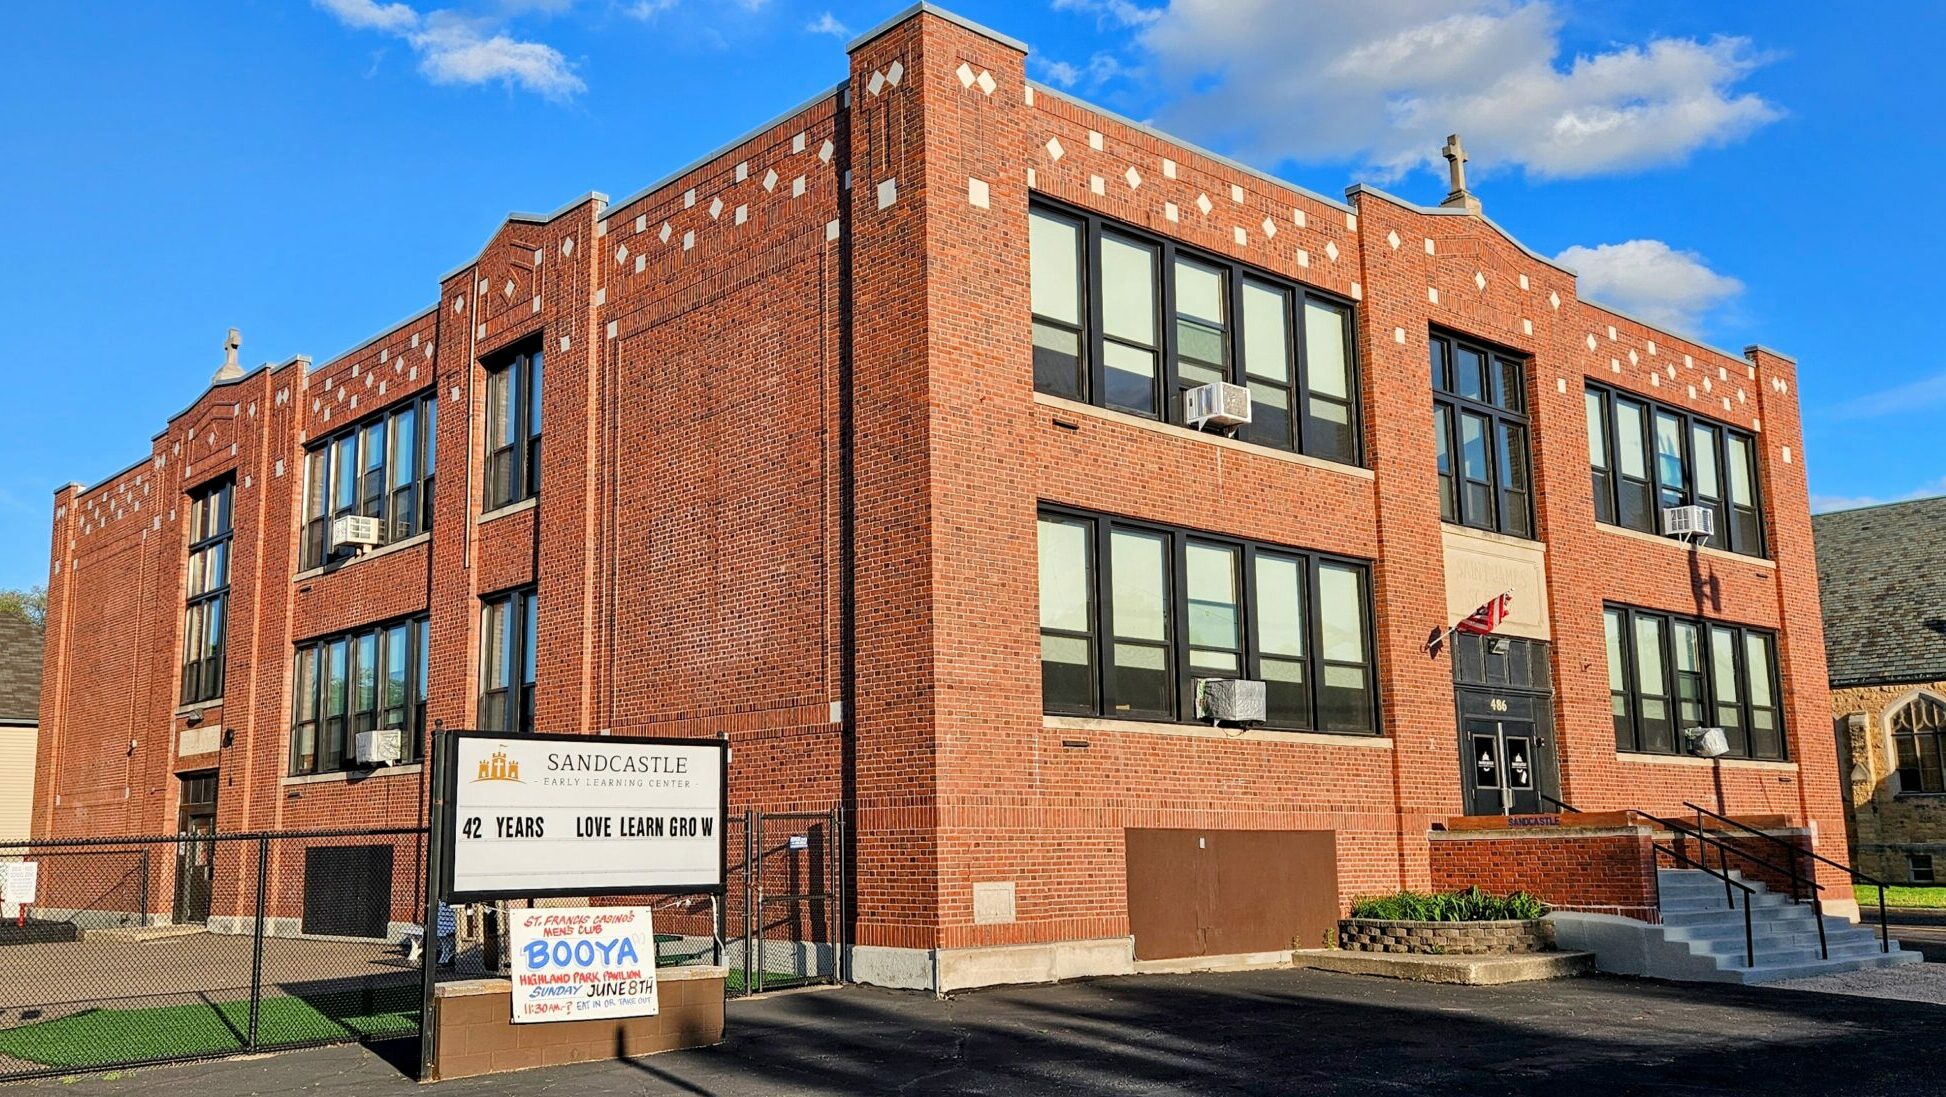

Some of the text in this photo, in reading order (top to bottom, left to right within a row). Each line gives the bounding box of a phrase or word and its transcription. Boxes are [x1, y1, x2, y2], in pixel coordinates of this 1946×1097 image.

[1490, 698, 1507, 712] 486
[547, 753, 688, 773] SANDCASTLE
[544, 777, 691, 788] EARLY LEARNING CENTER
[462, 817, 482, 838] 42
[496, 816, 544, 838] YEARS
[576, 816, 611, 838] LOVE
[620, 816, 664, 837] LEARN
[1508, 817, 1560, 827] SANDCASTLE
[523, 915, 542, 928] ST.
[543, 914, 591, 927] FRANCIS
[578, 924, 603, 935] CLUB
[523, 937, 639, 969] BOOYA
[519, 969, 642, 986] HIGHLAND PARK PAVILION
[528, 979, 654, 998] SUNDAY JUNE 8TH
[576, 1001, 590, 1011] EAT
[592, 1000, 601, 1008] IN
[604, 998, 615, 1008] OR
[620, 998, 636, 1006] TAKE
[638, 996, 651, 1005] OUT
